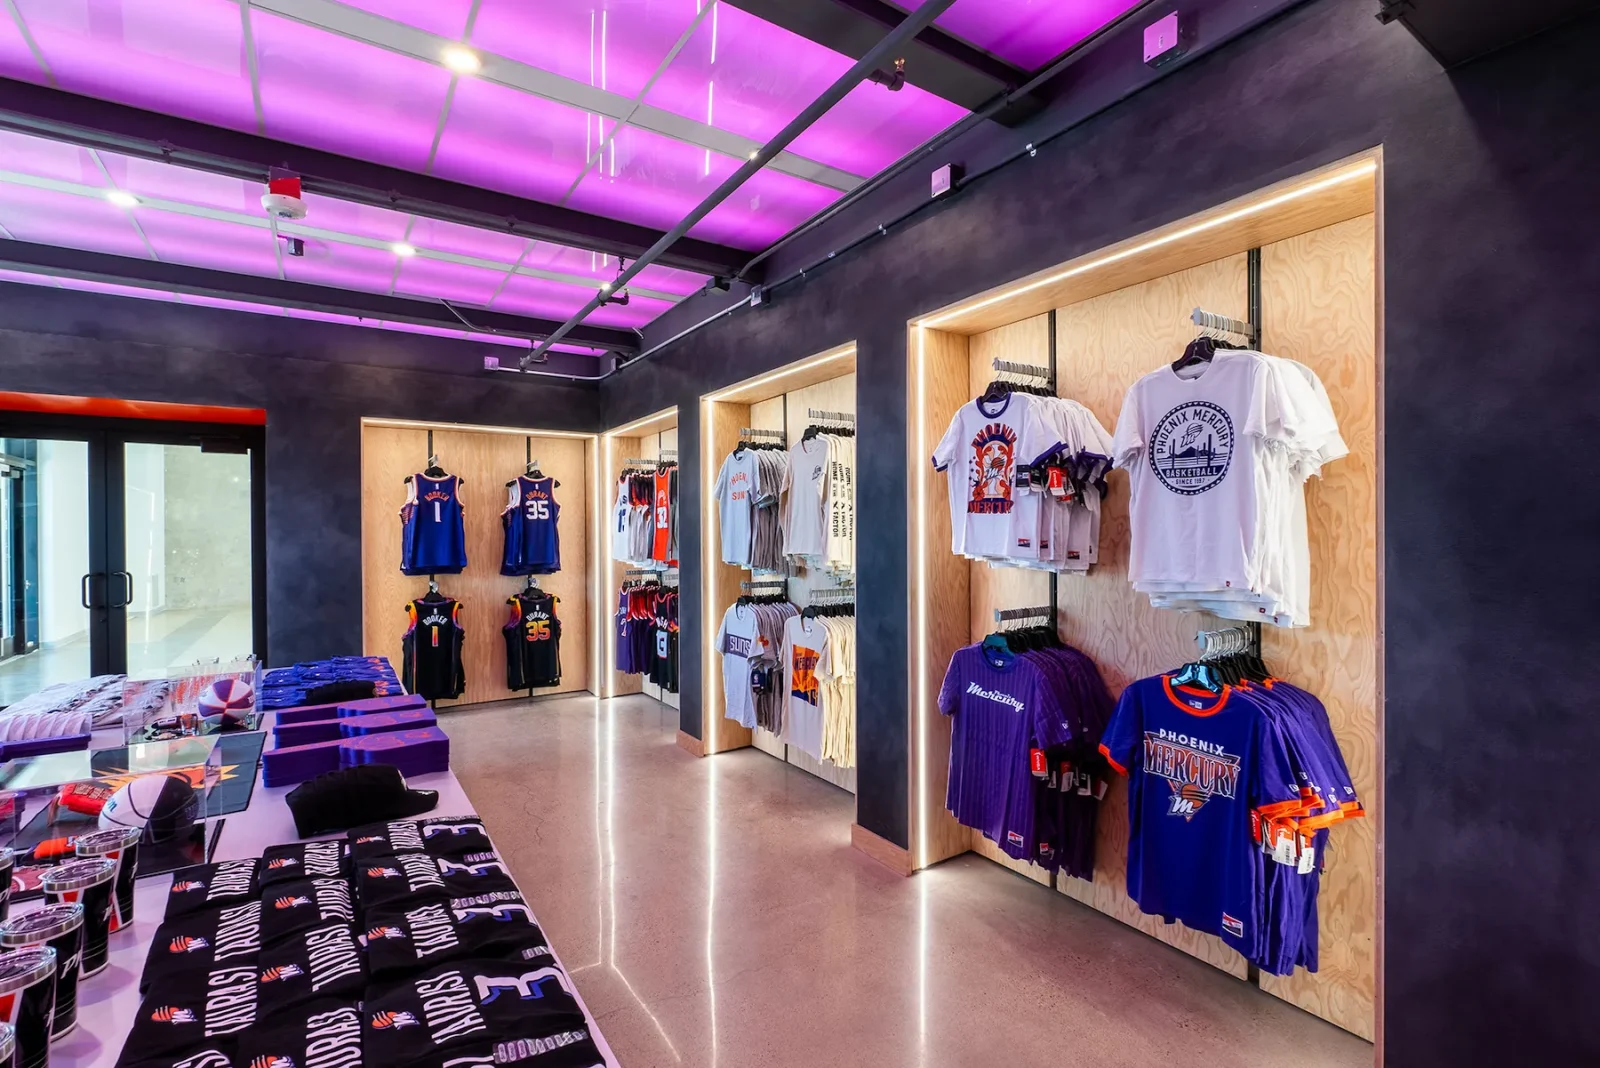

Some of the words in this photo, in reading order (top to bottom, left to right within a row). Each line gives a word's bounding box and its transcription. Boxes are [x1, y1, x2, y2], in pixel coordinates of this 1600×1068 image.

[1156, 411, 1189, 454] PHOENIX
[1192, 409, 1229, 448] MERCURY
[1165, 466, 1219, 478] BASKETBALL
[434, 501, 442, 523] 1
[525, 500, 550, 520] 35
[422, 614, 448, 626] BOOKER
[525, 620, 551, 642] 35
[526, 611, 550, 621] DURANT
[431, 625, 439, 647] 1
[966, 681, 1025, 713] Mercury
[1159, 728, 1225, 757] PHOENIX
[1143, 739, 1241, 800] MERCURY
[214, 900, 262, 962] TAURASI
[404, 903, 460, 959] TAURASI
[305, 923, 361, 992] TAURASI
[205, 966, 258, 1037] TAURASI
[415, 970, 487, 1044] TAURASI
